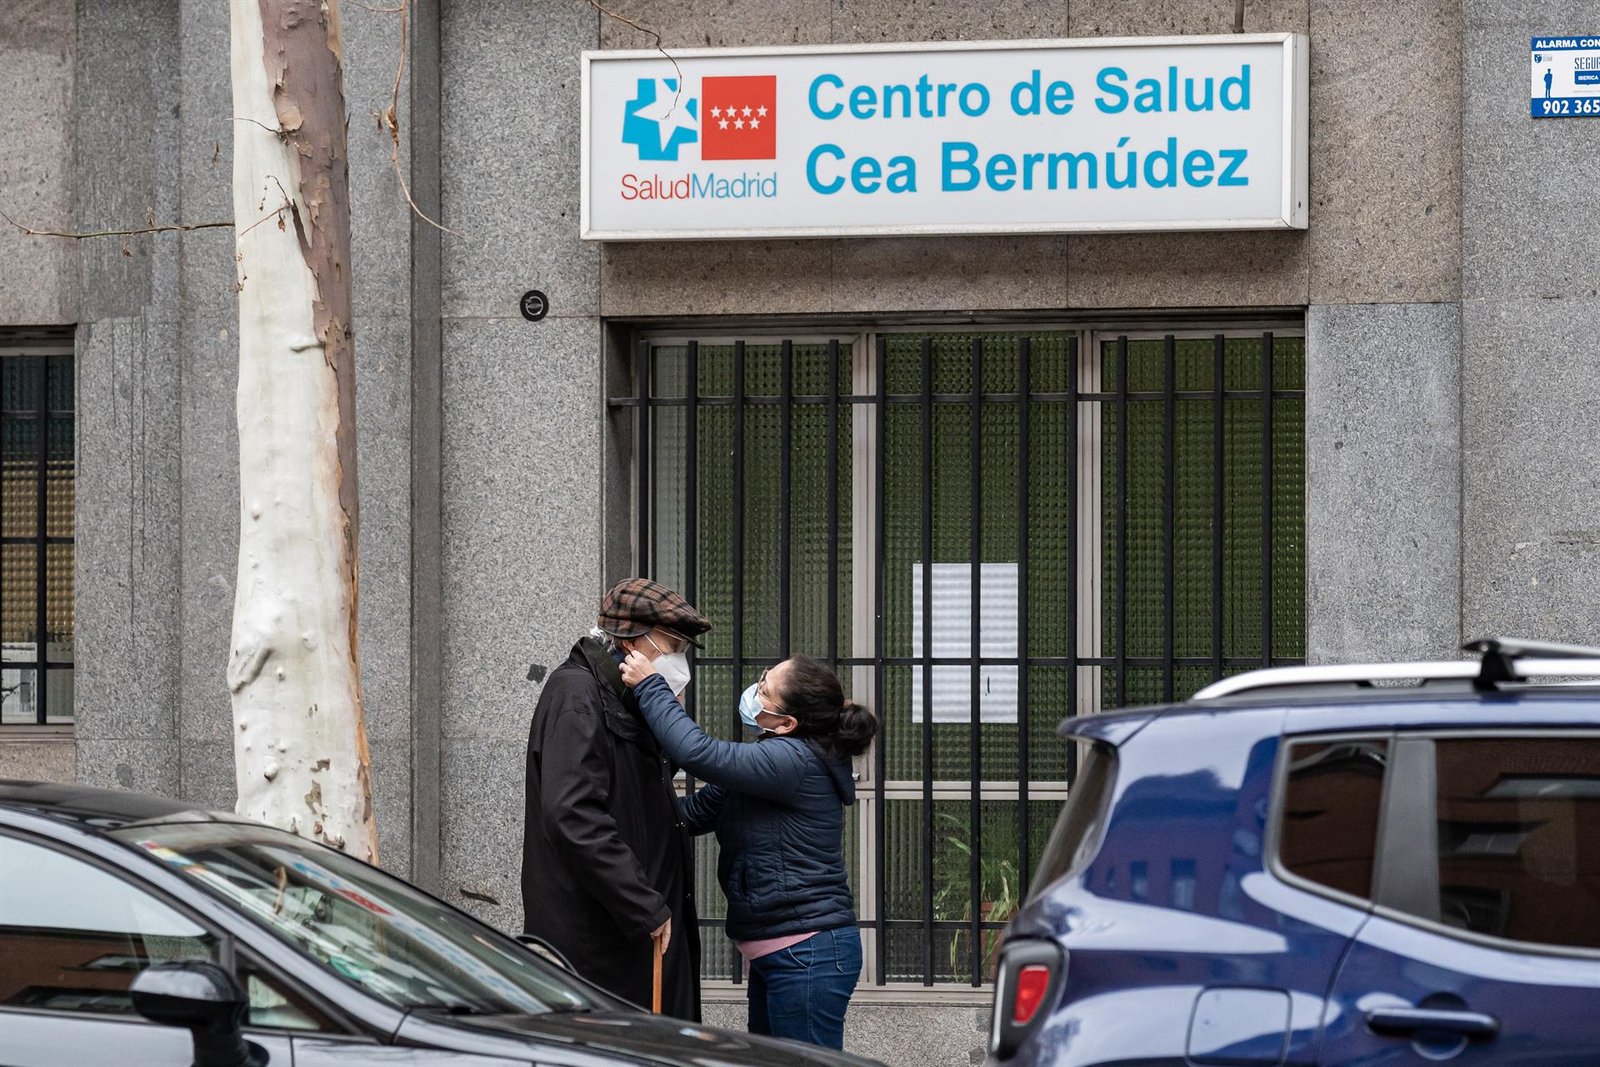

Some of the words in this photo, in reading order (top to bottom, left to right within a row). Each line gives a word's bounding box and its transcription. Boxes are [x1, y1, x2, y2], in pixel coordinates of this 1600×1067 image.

[1536, 40, 1577, 48] ALARMA
[808, 73, 991, 121] Centro
[1010, 69, 1075, 116] de
[1094, 64, 1251, 115] Salud
[1543, 100, 1569, 114] 902
[806, 143, 917, 195] Cea
[941, 136, 1249, 192] Bermúdez
[621, 172, 777, 200] SaludMadrid
